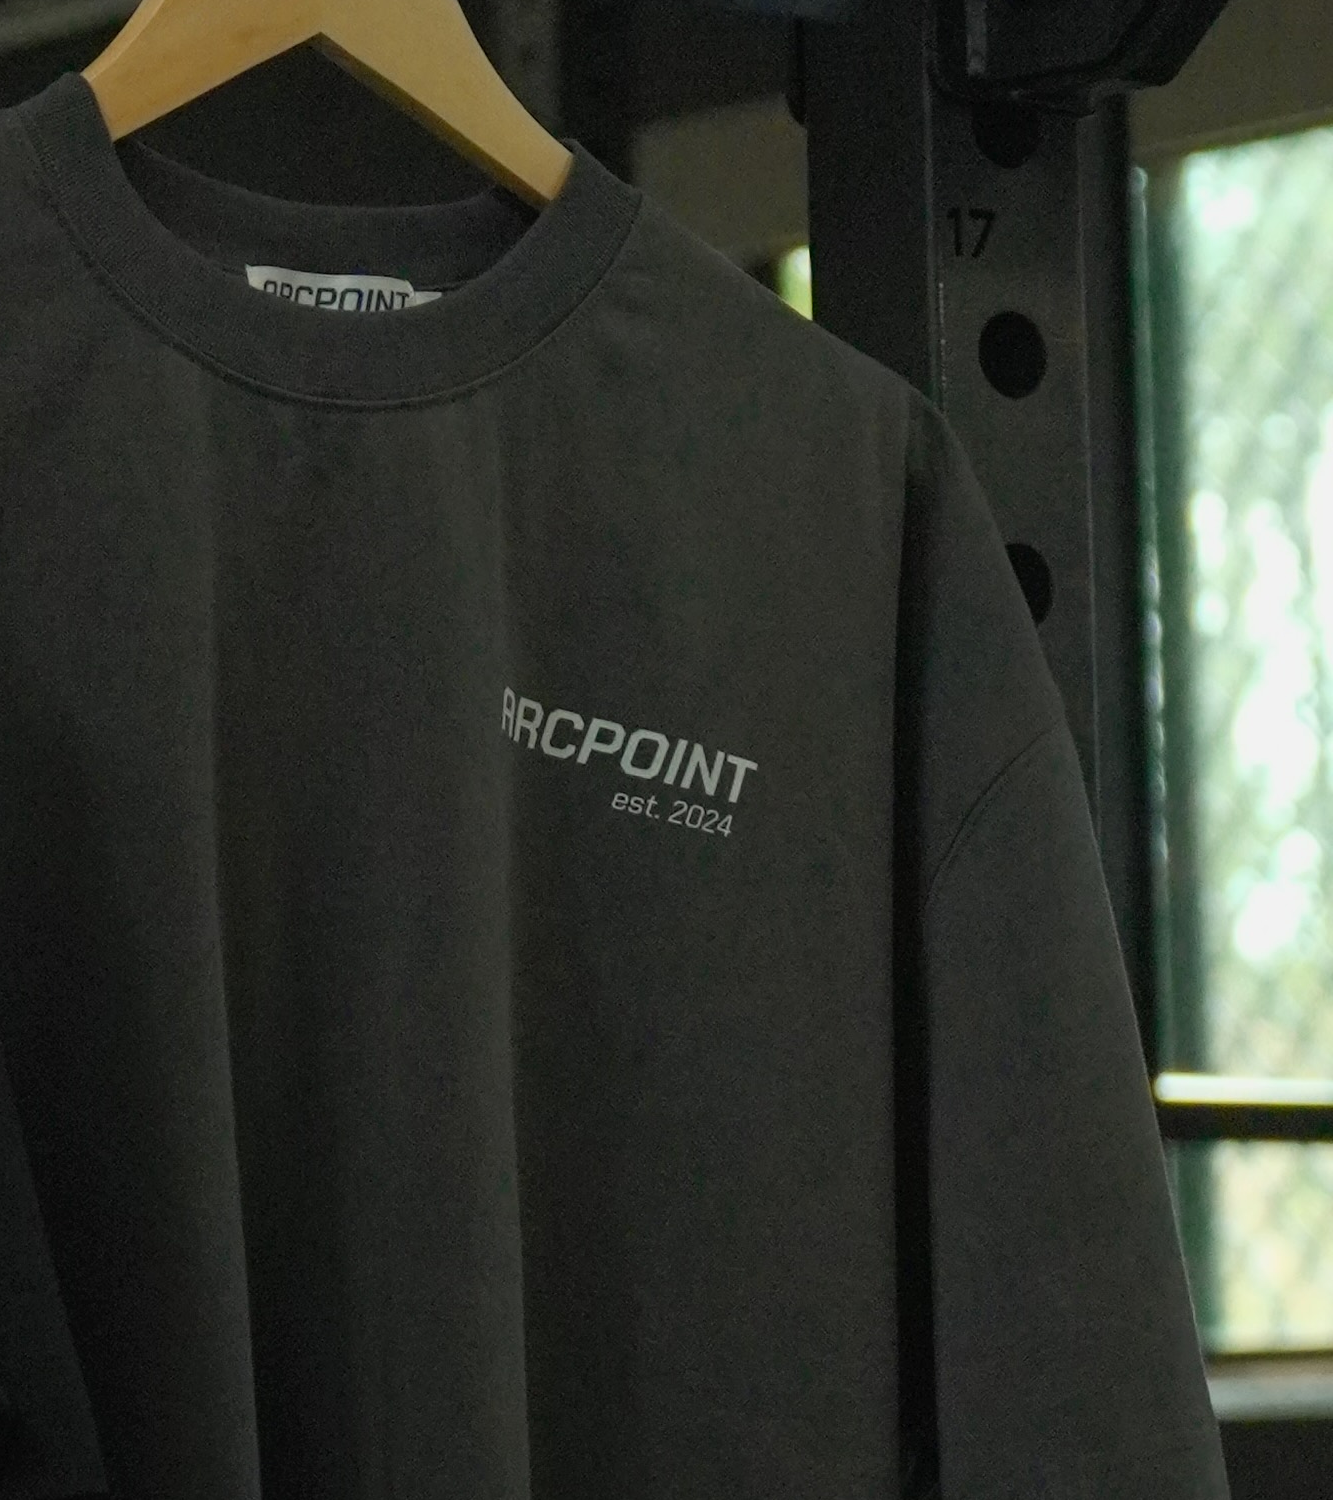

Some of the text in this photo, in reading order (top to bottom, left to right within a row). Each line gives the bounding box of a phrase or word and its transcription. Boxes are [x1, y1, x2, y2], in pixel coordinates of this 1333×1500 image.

[946, 207, 997, 259] 17
[501, 685, 759, 804] ARCPOINT
[610, 791, 734, 838] est. 2024
